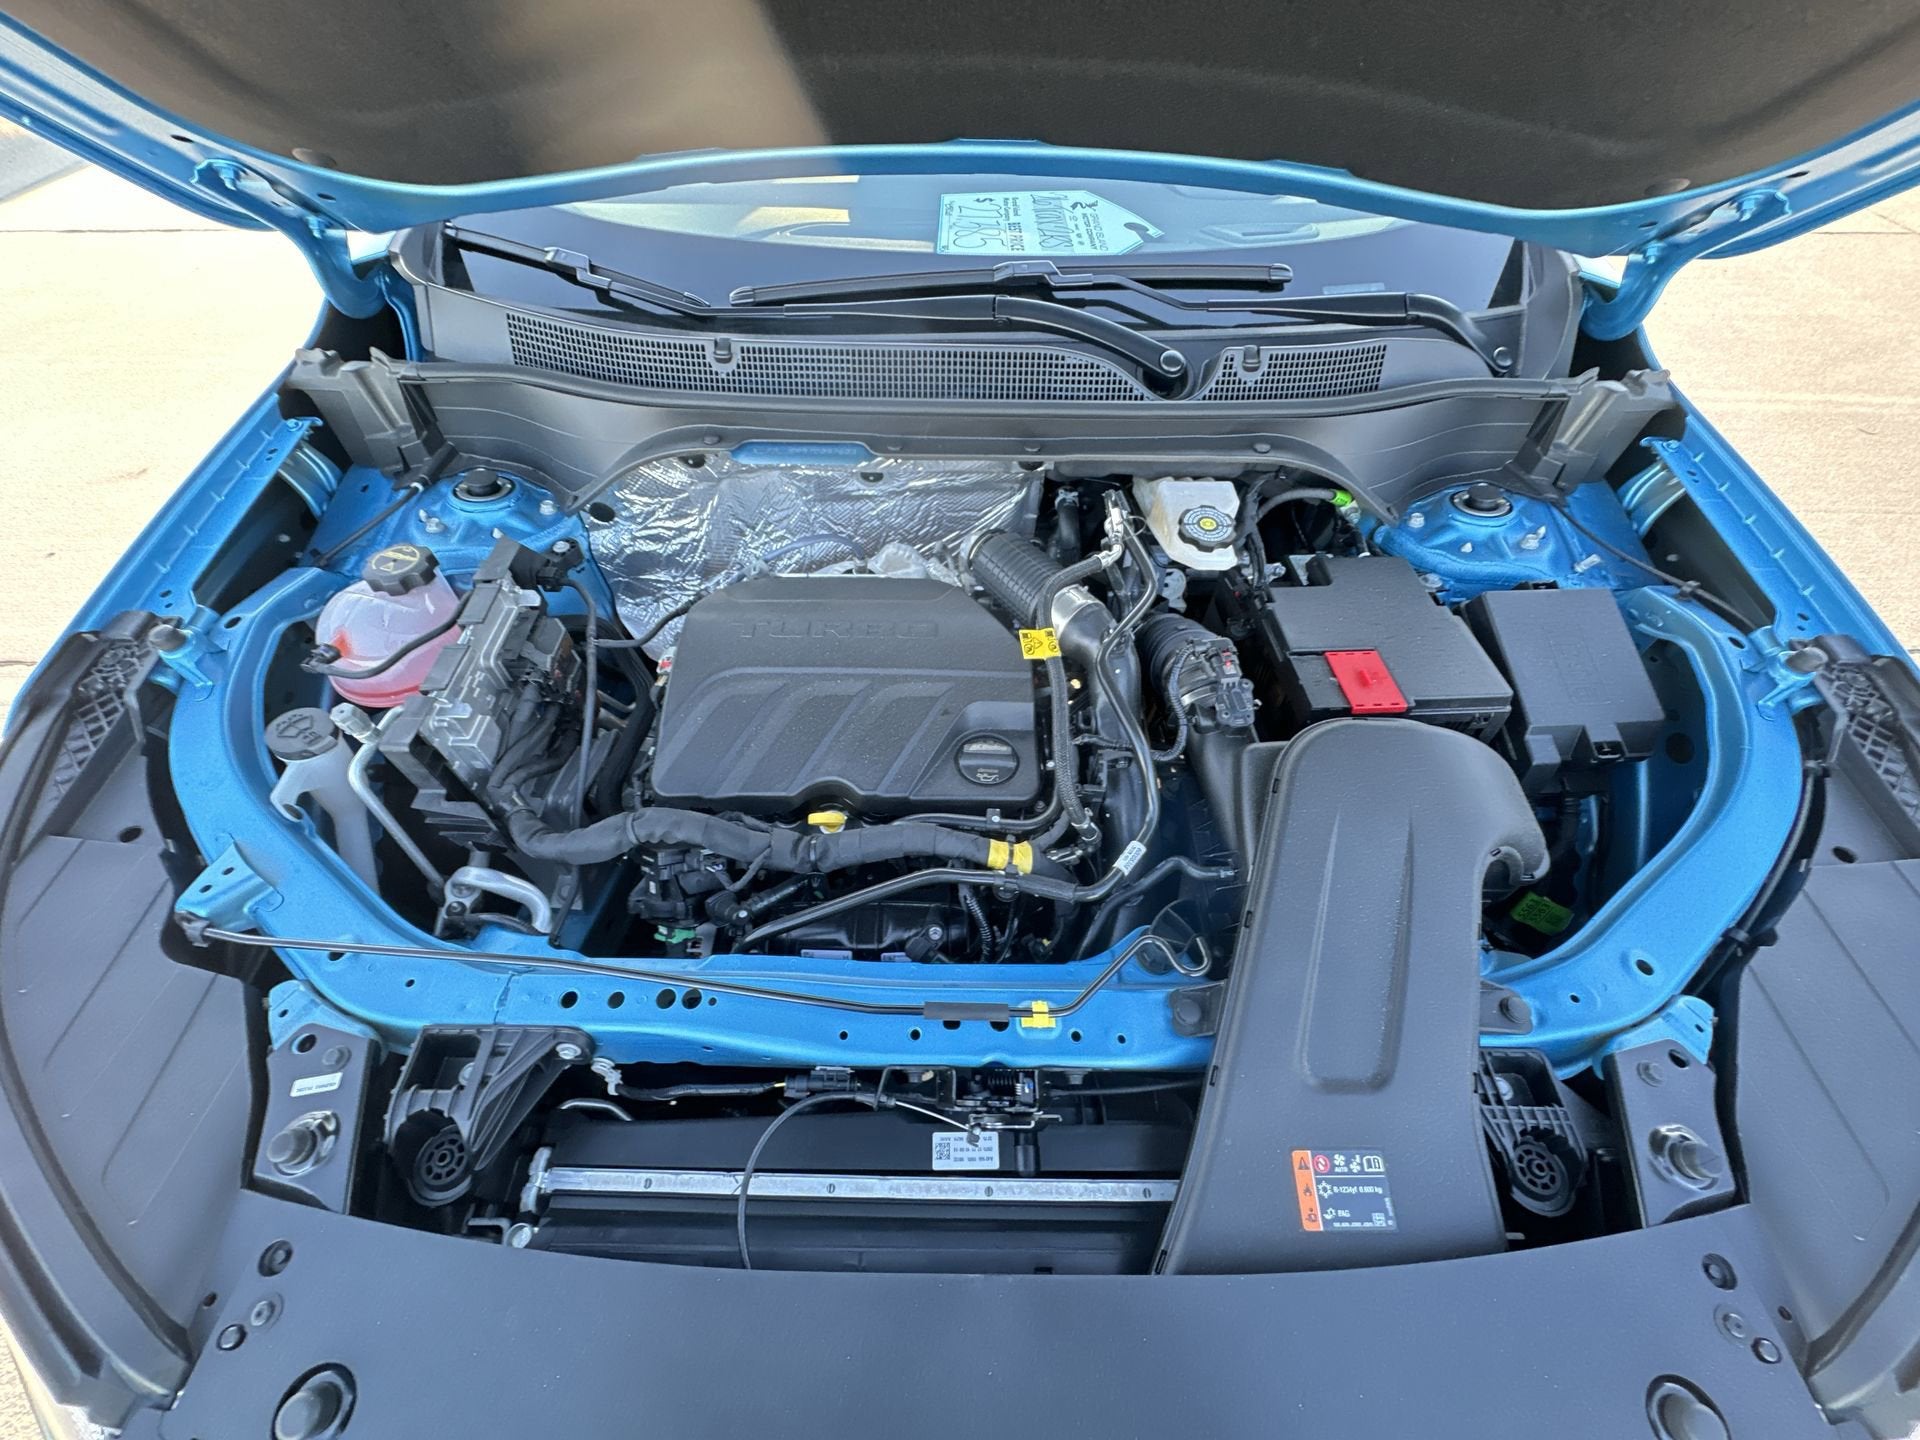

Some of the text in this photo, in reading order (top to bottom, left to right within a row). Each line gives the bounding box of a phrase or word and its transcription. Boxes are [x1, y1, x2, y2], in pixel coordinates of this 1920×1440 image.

[1082, 212, 1098, 250] MOTOR COMPANY
[730, 620, 938, 638] TURBO
